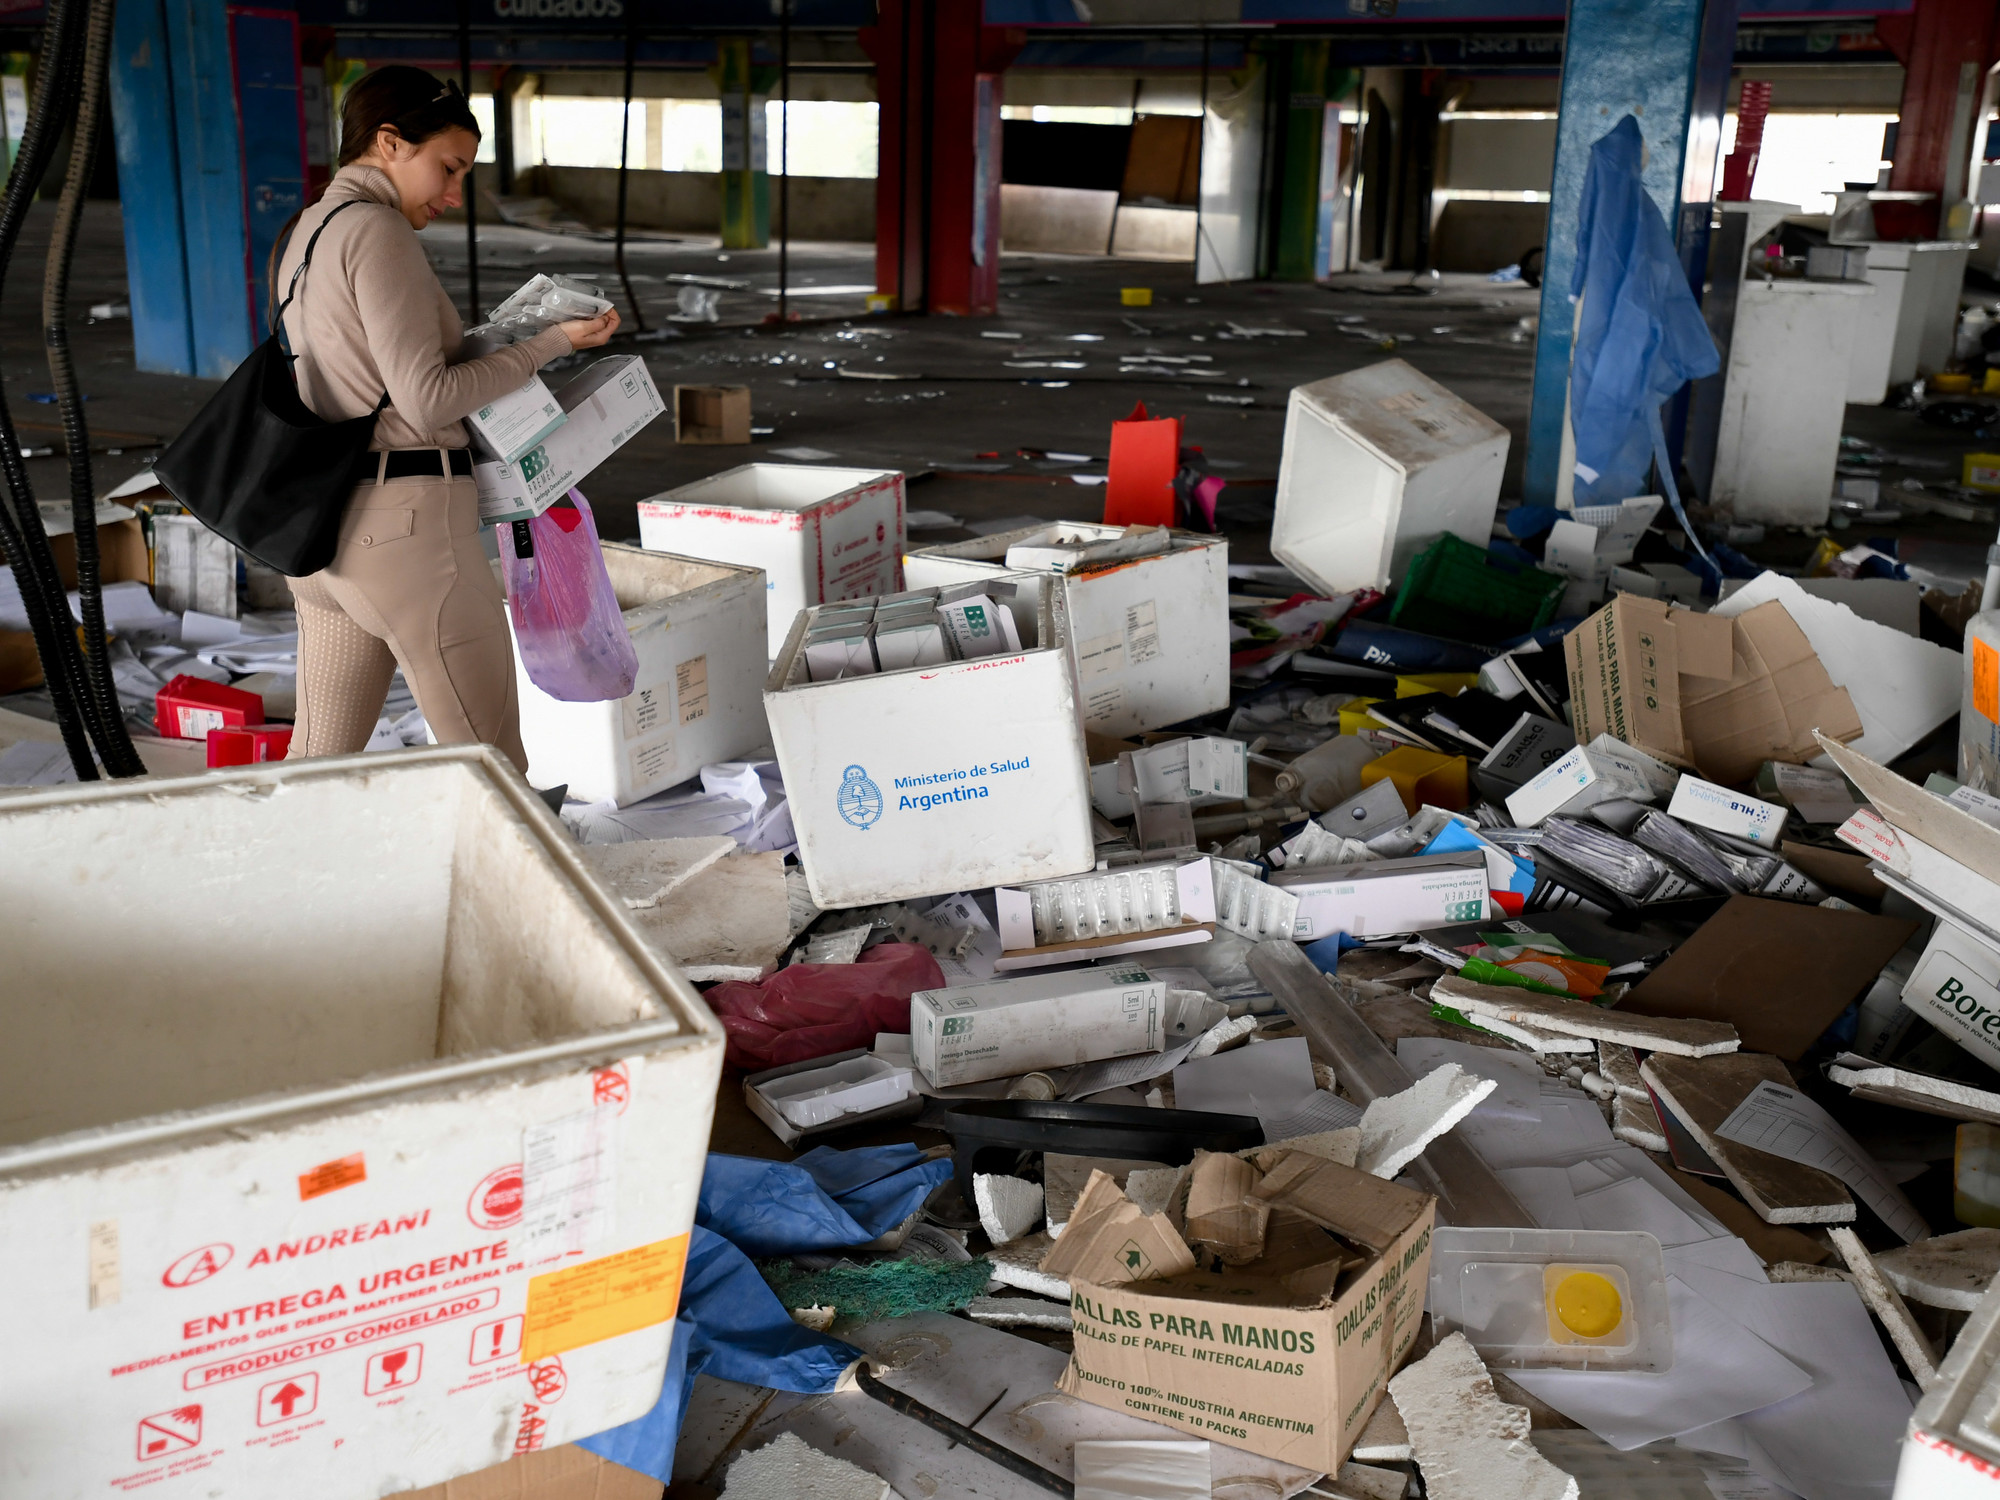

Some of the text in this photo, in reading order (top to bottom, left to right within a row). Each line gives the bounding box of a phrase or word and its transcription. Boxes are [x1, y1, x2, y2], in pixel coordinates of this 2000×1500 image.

[528, 467, 556, 495] BREMEN
[534, 488, 551, 504] Jeringa
[549, 470, 573, 491] Desechable
[945, 610, 956, 634] Jeringa
[954, 607, 972, 642] BREMEN
[1595, 619, 1606, 654] TOALLAS
[1575, 633, 1584, 670] PRODUCTO
[1599, 654, 1605, 664] DE
[1600, 664, 1608, 688] PAPEL
[1603, 603, 1627, 743] TOALLAS PARA MANOS
[1579, 688, 1589, 722] INDUSTRIA
[894, 756, 1030, 789] Ministerio de Salud
[898, 785, 989, 811] Argentina
[1422, 879, 1482, 891] Jeringa Desechable
[1444, 889, 1483, 902] BREMEN
[1127, 994, 1140, 1006] 5ml
[1936, 1003, 1954, 1019] MEJOR
[1954, 1016, 1970, 1031] PAPEL
[1970, 1028, 1983, 1039] POR
[940, 1034, 974, 1047] BREMEN
[941, 1050, 964, 1061] Jeringa
[964, 1045, 1000, 1056] Desechable
[247, 1208, 431, 1269] ANDREANI
[182, 1283, 347, 1340] ENTREGA
[358, 1239, 508, 1295] URGENTE
[1336, 1224, 1431, 1347] TOALLAS PARA MANOS
[111, 1260, 525, 1378] MEDICAMENTOS QUE DEBEN MANTENER CADENA DE
[1071, 1291, 1315, 1354] ALLAS PARA MANOS
[1361, 1312, 1383, 1348] PAPEL
[203, 1297, 481, 1384] PRODUCTO CONGELADO
[1121, 1335, 1140, 1348] DE
[1144, 1338, 1187, 1357] PAPEL
[1192, 1348, 1304, 1377] INTERCALADAS
[1393, 1330, 1411, 1360] CAJAS
[1125, 1398, 1248, 1440] CONTIENE 10 PACKS
[1130, 1384, 1164, 1399] 100%
[1167, 1392, 1235, 1418] INDUSTRIA
[1238, 1411, 1314, 1435] ARGENTINA
